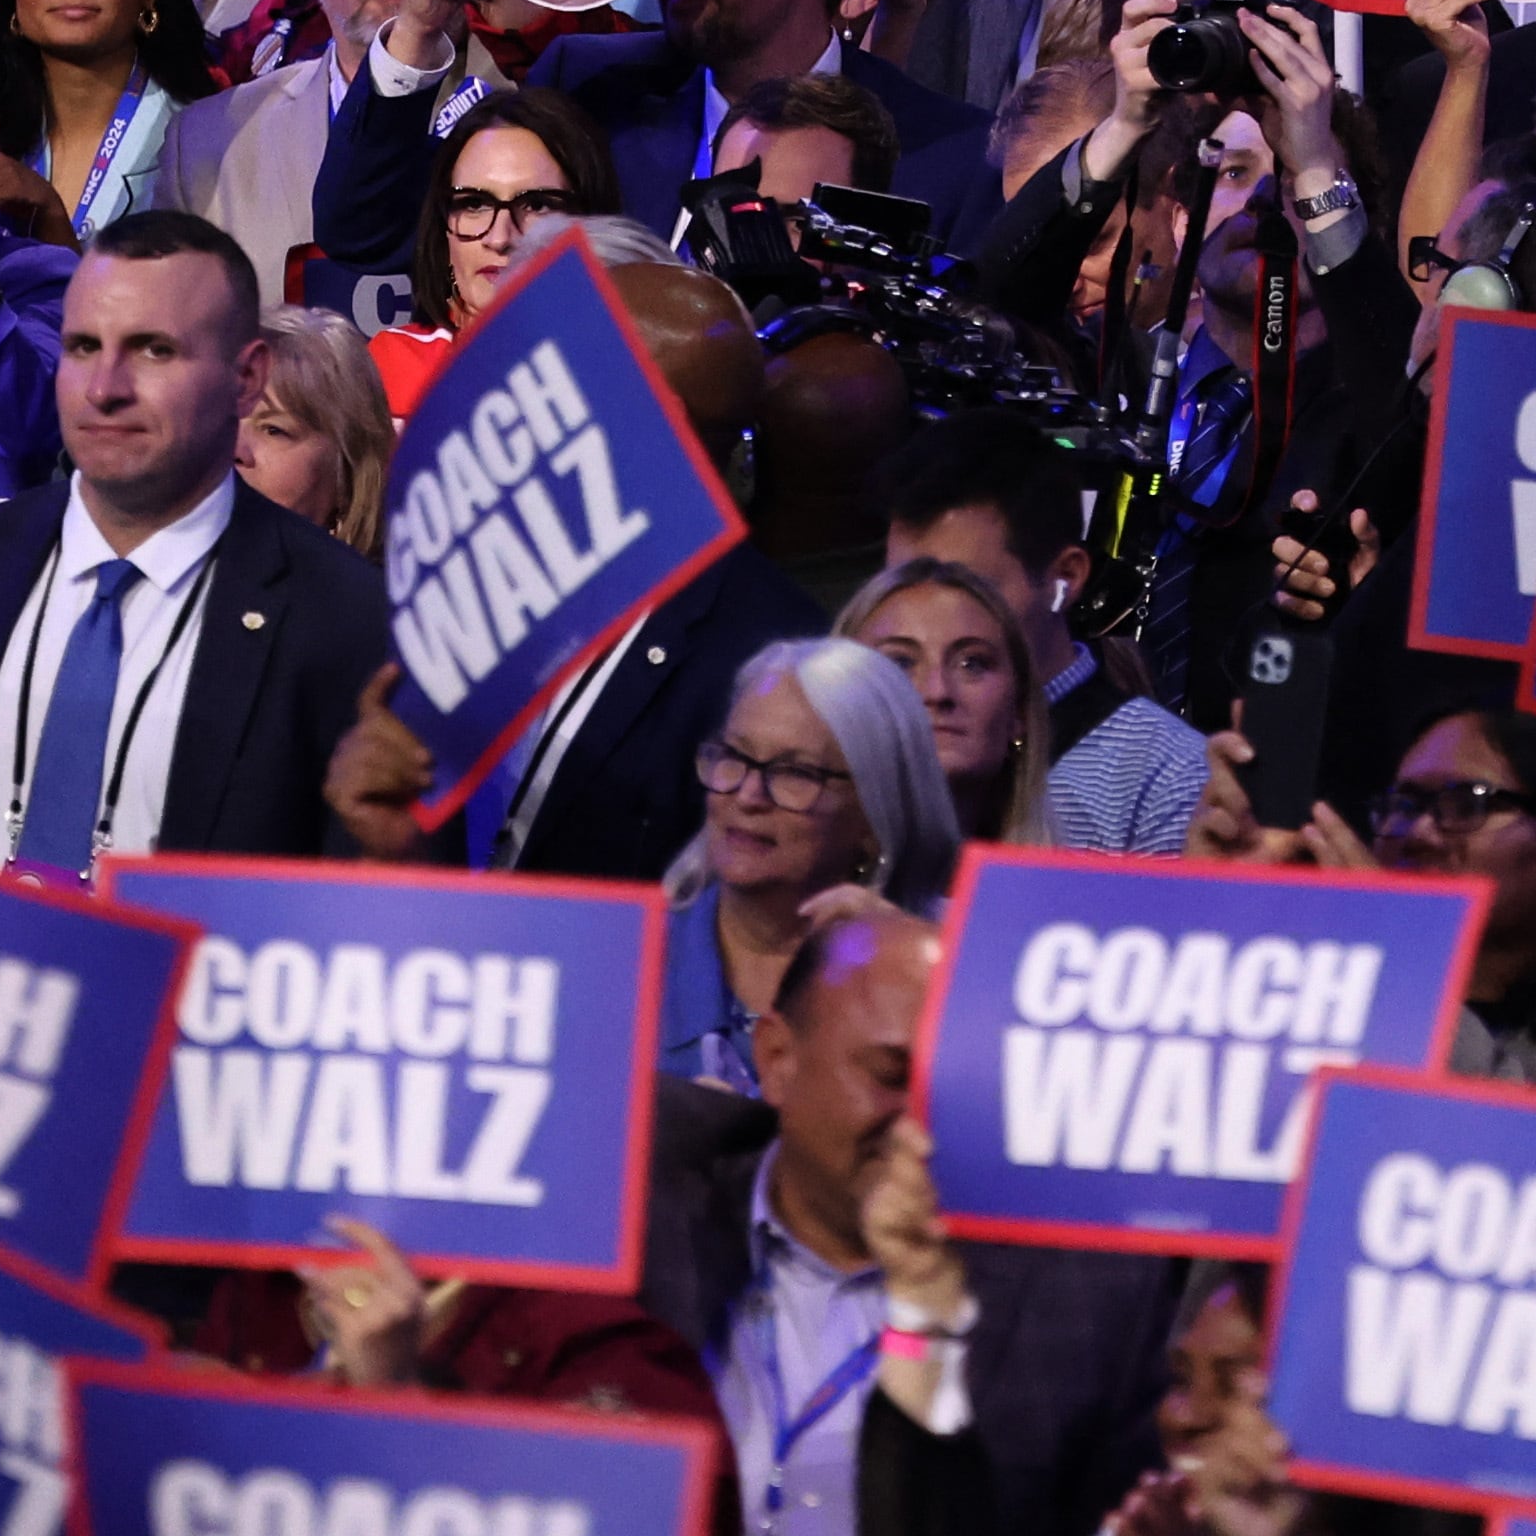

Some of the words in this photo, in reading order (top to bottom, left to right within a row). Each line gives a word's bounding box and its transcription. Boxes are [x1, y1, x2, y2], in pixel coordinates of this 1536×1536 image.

[101, 118, 126, 159] 2024
[1264, 275, 1284, 352] Canon
[386, 338, 589, 603] COACH
[392, 423, 651, 715] WALZ
[176, 936, 559, 1064] COACH
[1013, 920, 1384, 1046] COACH
[170, 1045, 553, 1208] WALZ
